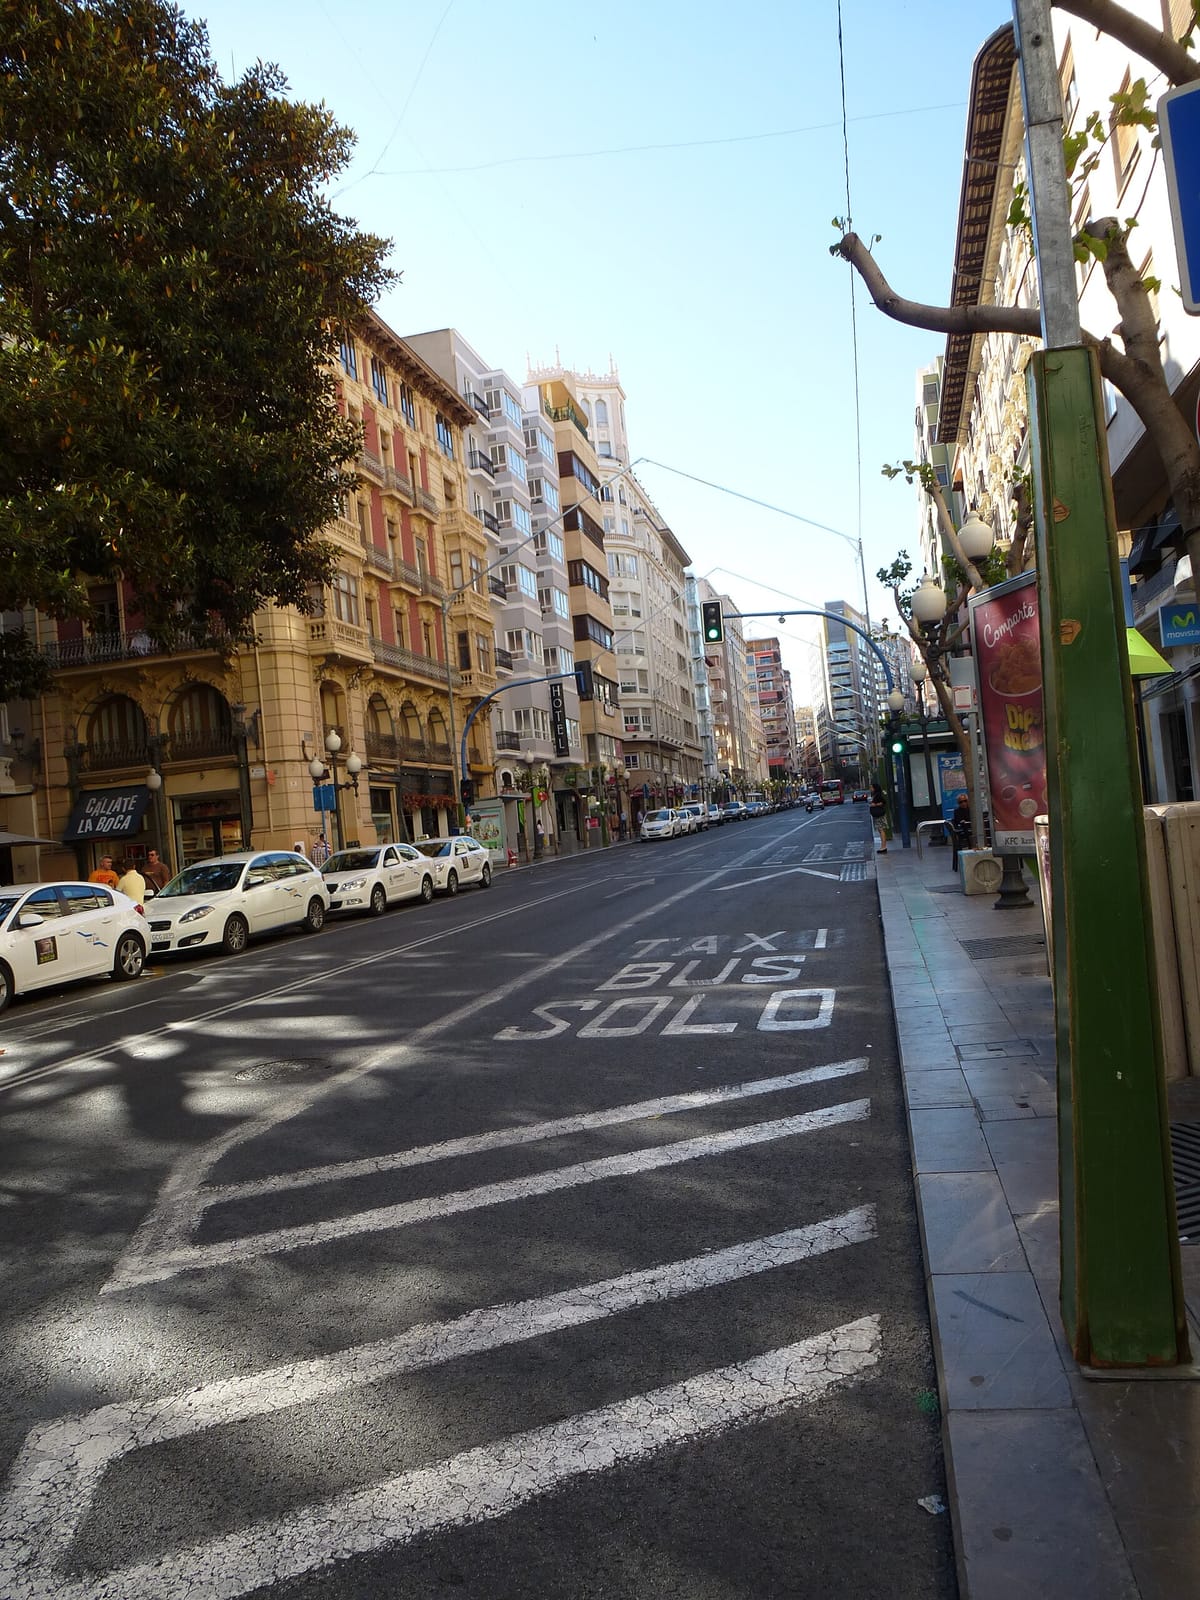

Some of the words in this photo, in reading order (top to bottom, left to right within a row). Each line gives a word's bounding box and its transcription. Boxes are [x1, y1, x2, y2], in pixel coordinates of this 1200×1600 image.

[983, 602, 1036, 649] Comparte
[552, 685, 566, 749] HOTEL
[77, 818, 93, 834] LA
[95, 814, 132, 833] BOCA
[1004, 836, 1019, 846] KFC
[631, 928, 828, 959] TAXI
[594, 955, 806, 991] BUS
[493, 988, 836, 1040] SOLO
